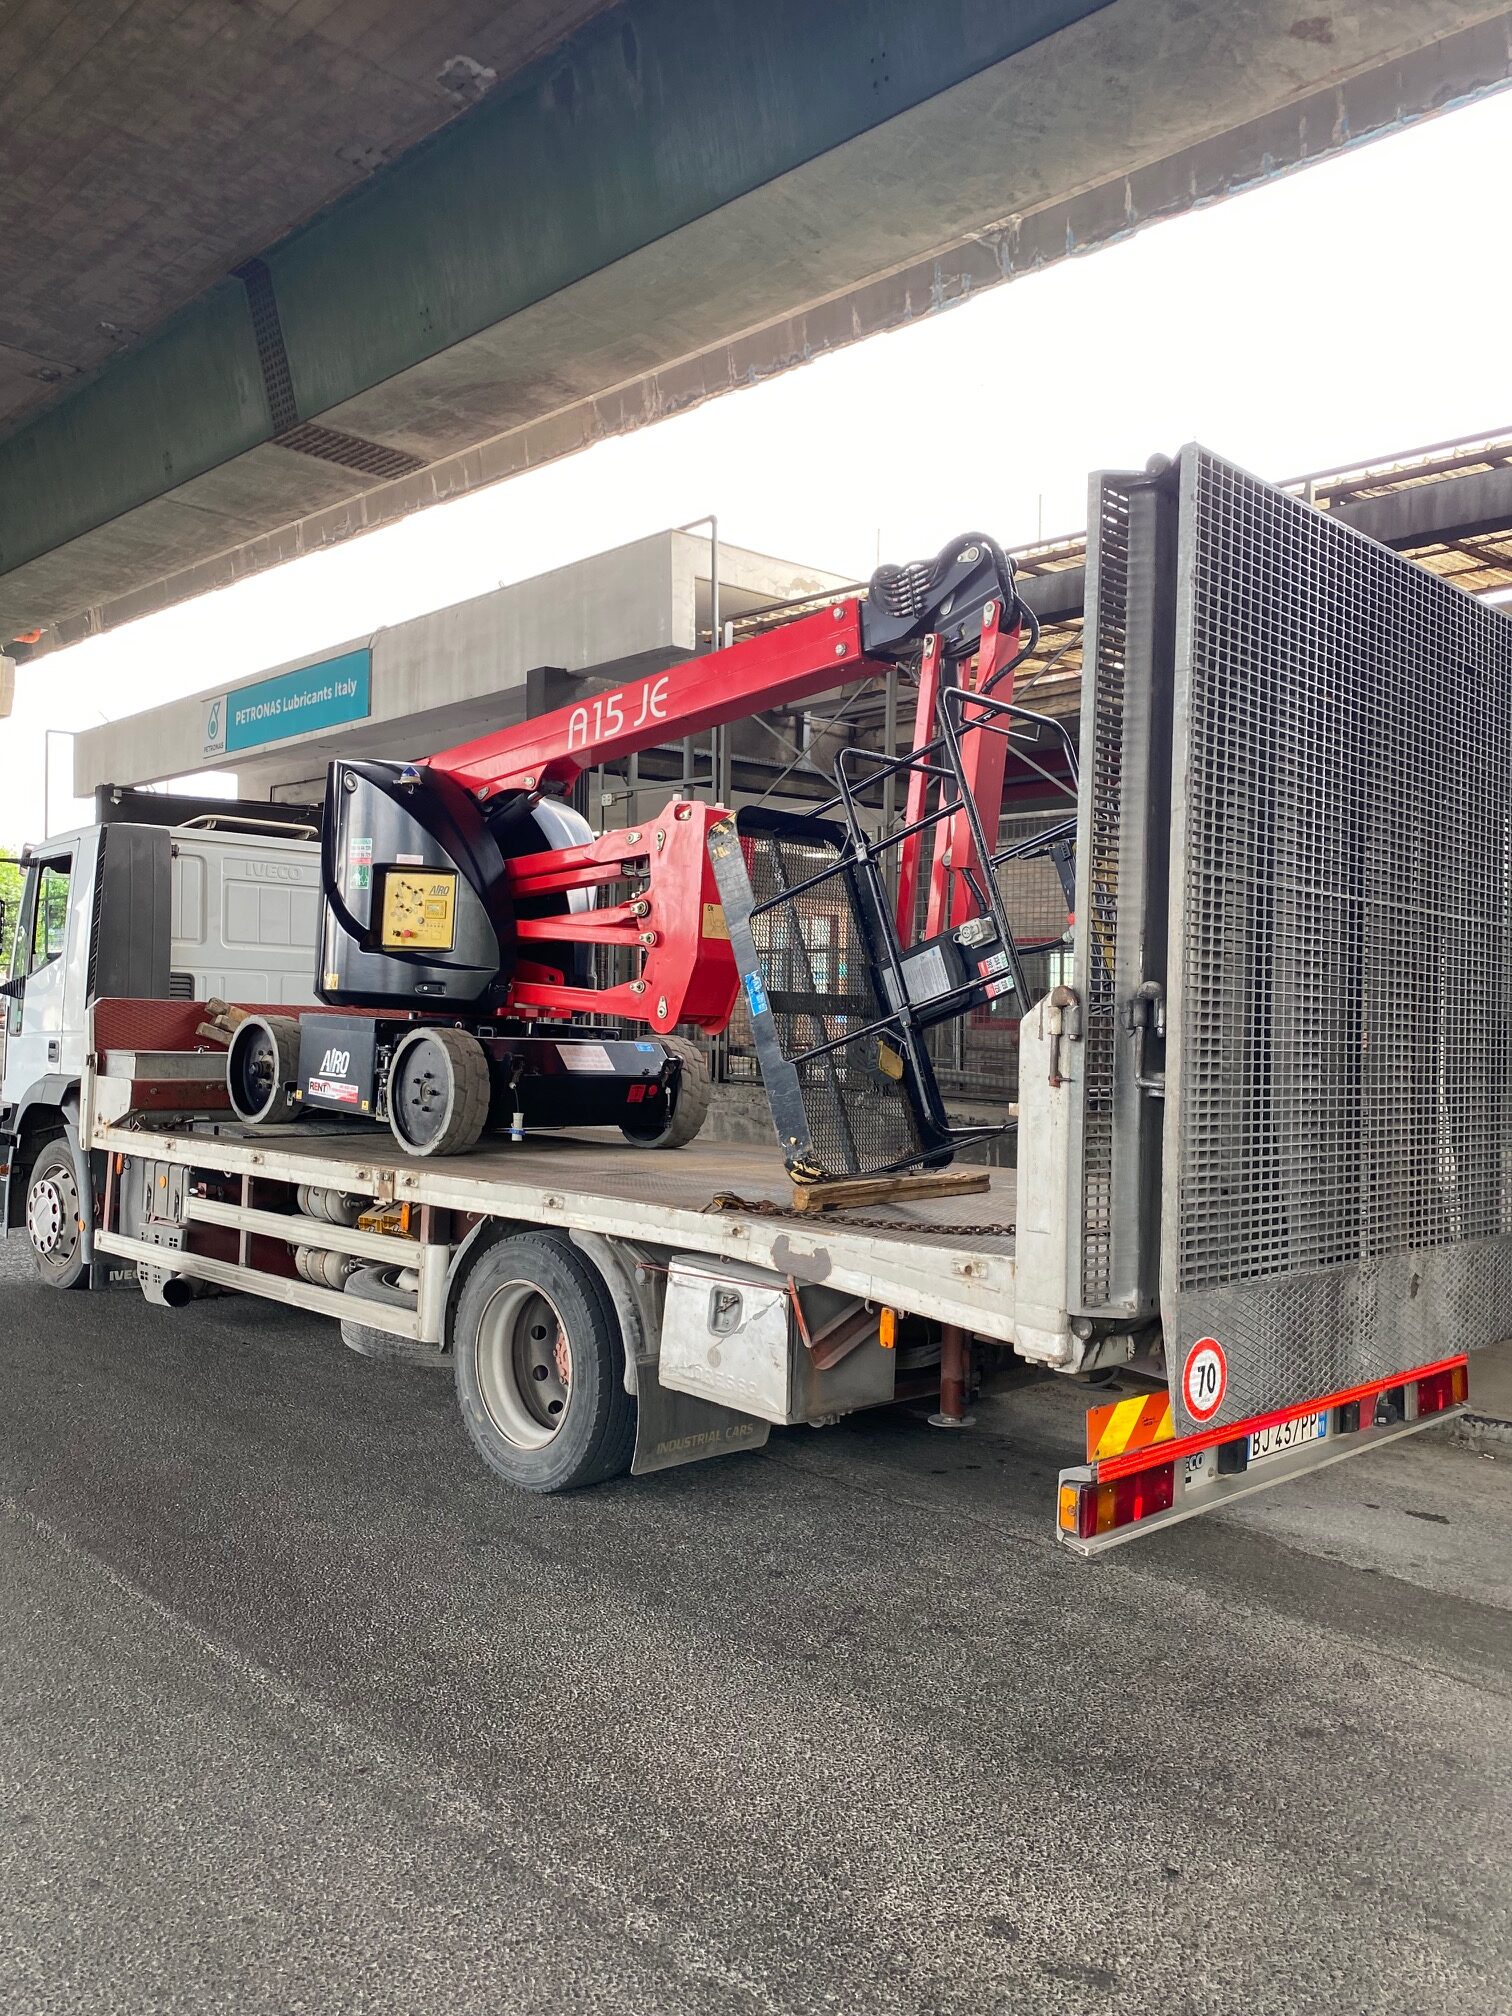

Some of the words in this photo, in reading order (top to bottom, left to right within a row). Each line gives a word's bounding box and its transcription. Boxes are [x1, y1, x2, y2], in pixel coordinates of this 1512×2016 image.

[235, 698, 281, 726] PETRONAS
[283, 686, 333, 712] Lubricants
[334, 678, 358, 698] Italy
[567, 693, 624, 750] A15
[633, 676, 669, 727] JE
[203, 741, 224, 753] PETRONAS
[244, 862, 304, 881] IVECO
[429, 885, 450, 896] AIRO
[319, 1047, 350, 1076] AIRO
[310, 1081, 327, 1093] RENT
[109, 1269, 138, 1281] IVEC
[1197, 1362, 1216, 1397] 70
[656, 1429, 721, 1455] INDUSTRIAL
[725, 1423, 754, 1439] CARS
